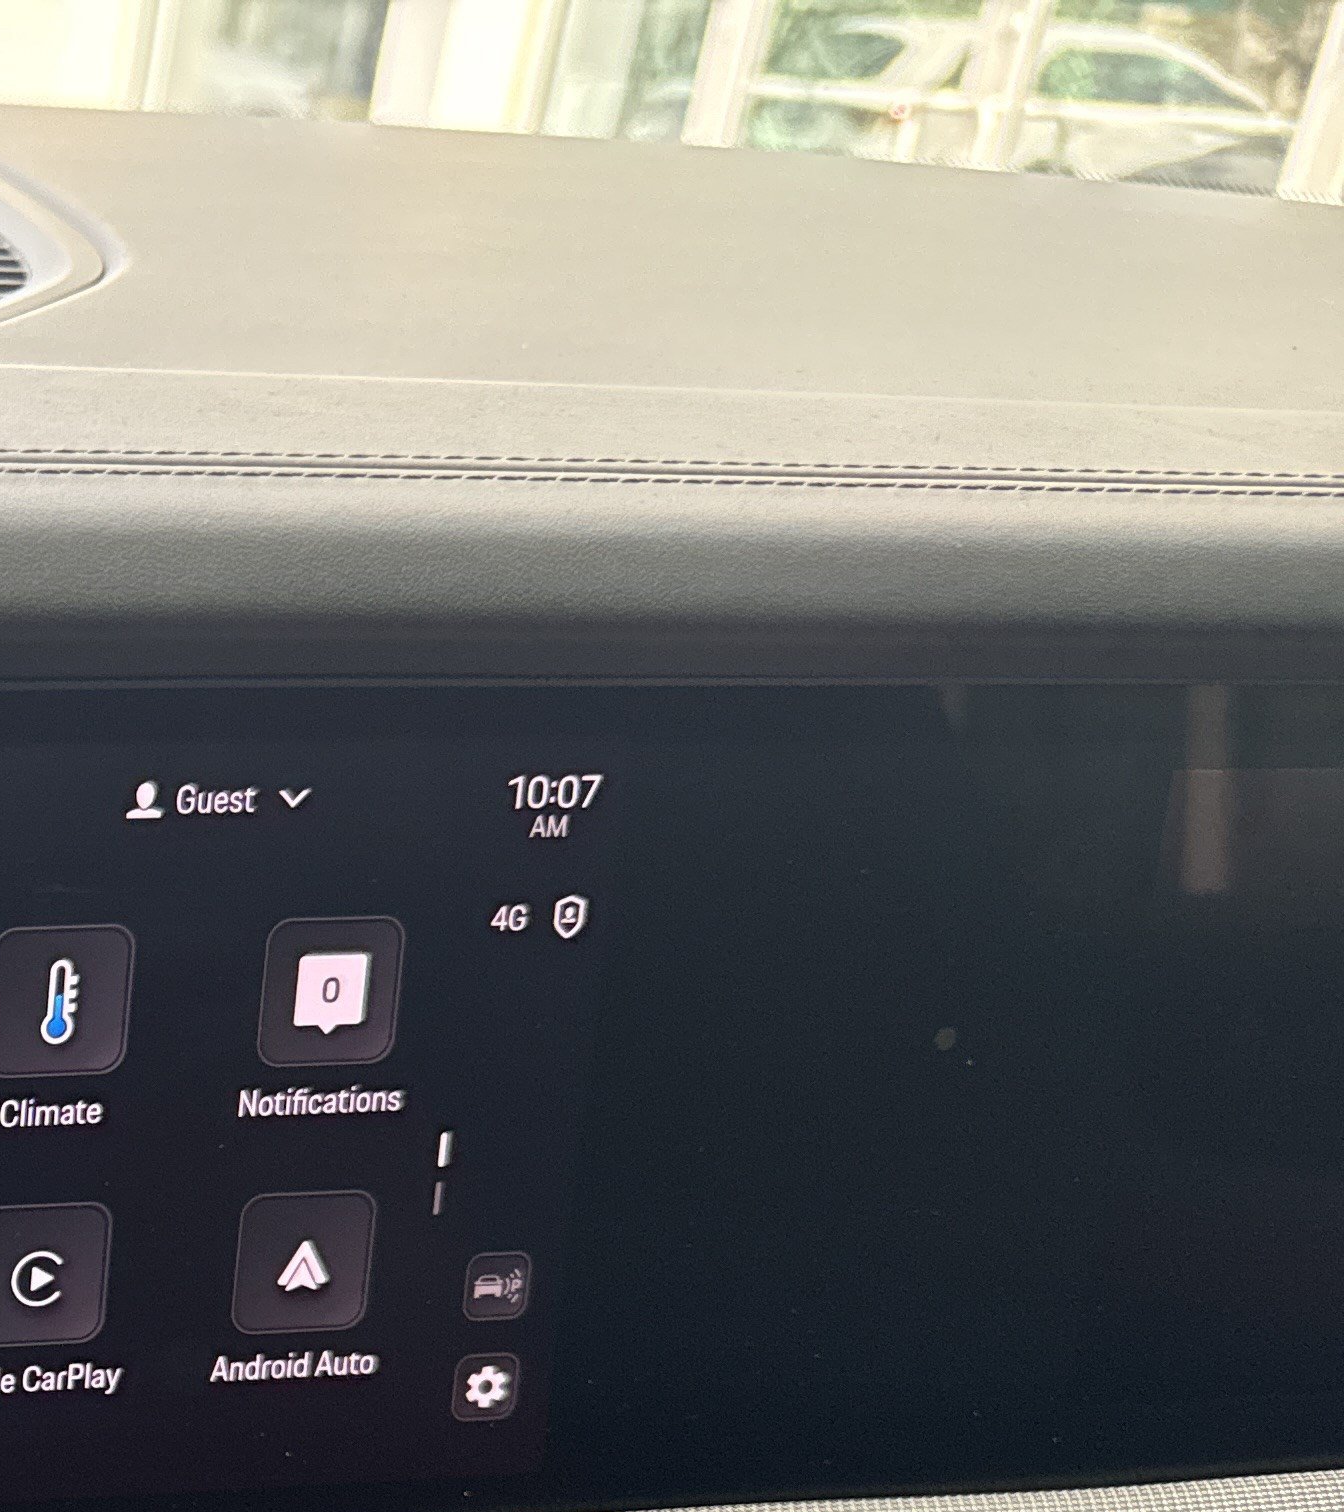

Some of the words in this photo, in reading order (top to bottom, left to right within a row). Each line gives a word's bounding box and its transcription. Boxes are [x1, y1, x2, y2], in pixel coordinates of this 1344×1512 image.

[176, 785, 257, 815] Guest
[508, 774, 604, 810] 10:07
[529, 815, 569, 838] AM
[491, 905, 530, 931] 4G
[0, 1099, 103, 1129] Climate
[238, 1085, 403, 1118] Notifications
[22, 1363, 123, 1395] CarPlay
[210, 1353, 309, 1384] Android
[315, 1350, 377, 1378] Auto
